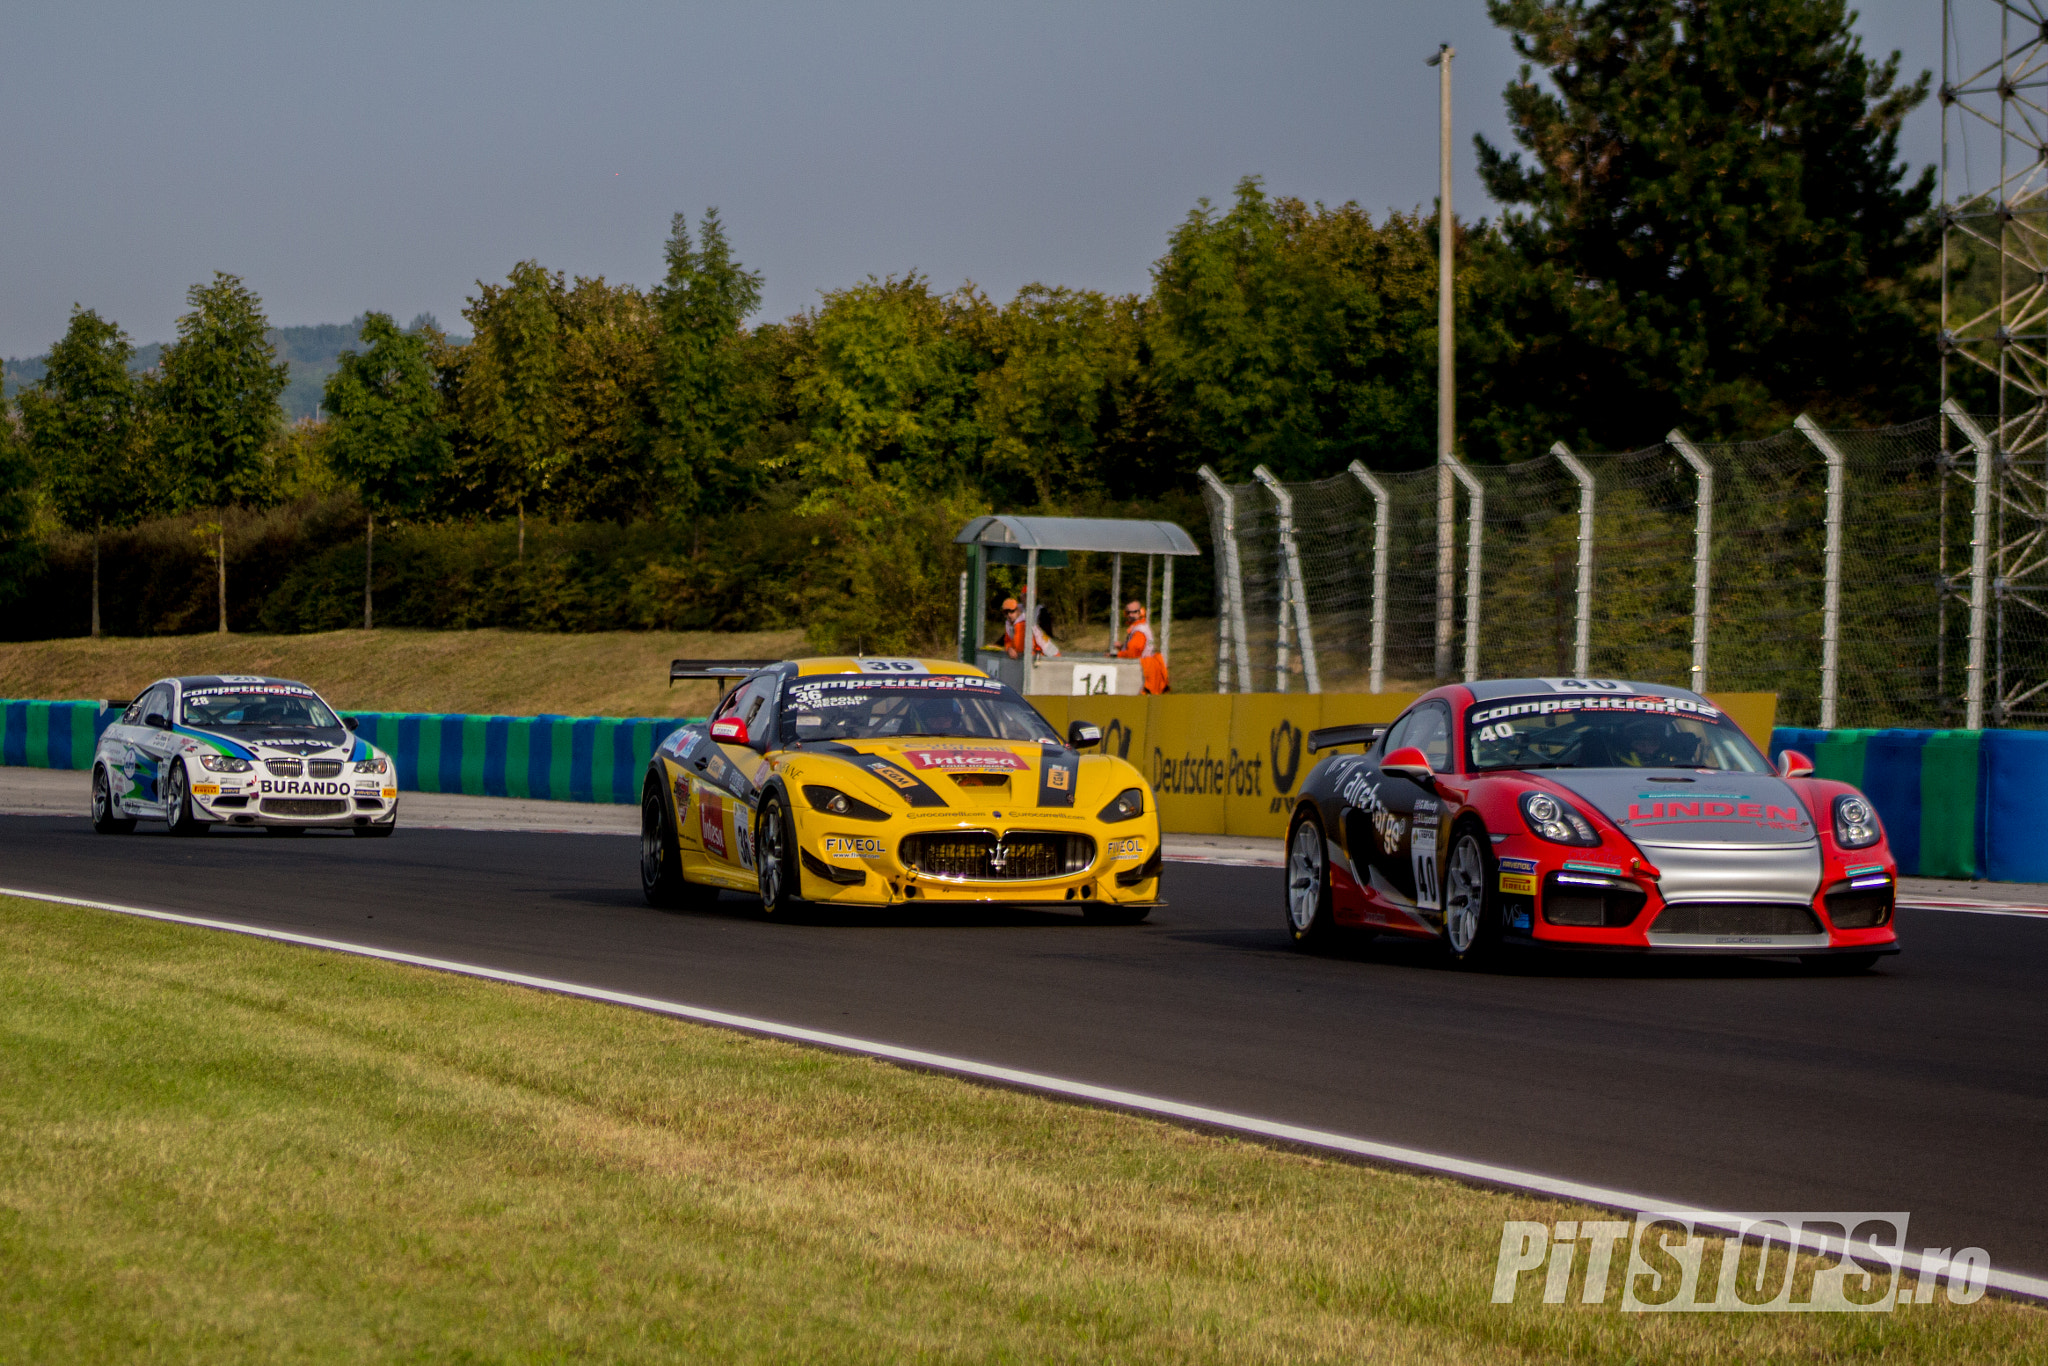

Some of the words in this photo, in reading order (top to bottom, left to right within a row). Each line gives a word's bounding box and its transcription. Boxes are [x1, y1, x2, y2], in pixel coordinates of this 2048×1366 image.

[867, 661, 914, 672] 36
[1080, 673, 1109, 696] 14
[1561, 679, 1617, 690] 40
[190, 696, 209, 706] 28
[795, 690, 822, 703] 36
[1479, 723, 1514, 742] 40
[252, 738, 336, 749] TREFOIL
[919, 753, 1018, 767] Intesa
[1153, 745, 1224, 795] Deutsche
[1227, 748, 1262, 796] Post
[260, 780, 351, 796] BURANDO
[1628, 802, 1798, 821] LINDEN
[826, 838, 886, 853] FIVEOL
[1108, 840, 1143, 855] FIVEOL
[1502, 860, 1532, 871] RAVENOL
[1417, 855, 1437, 903] 40
[1502, 877, 1531, 892] PIRELLI
